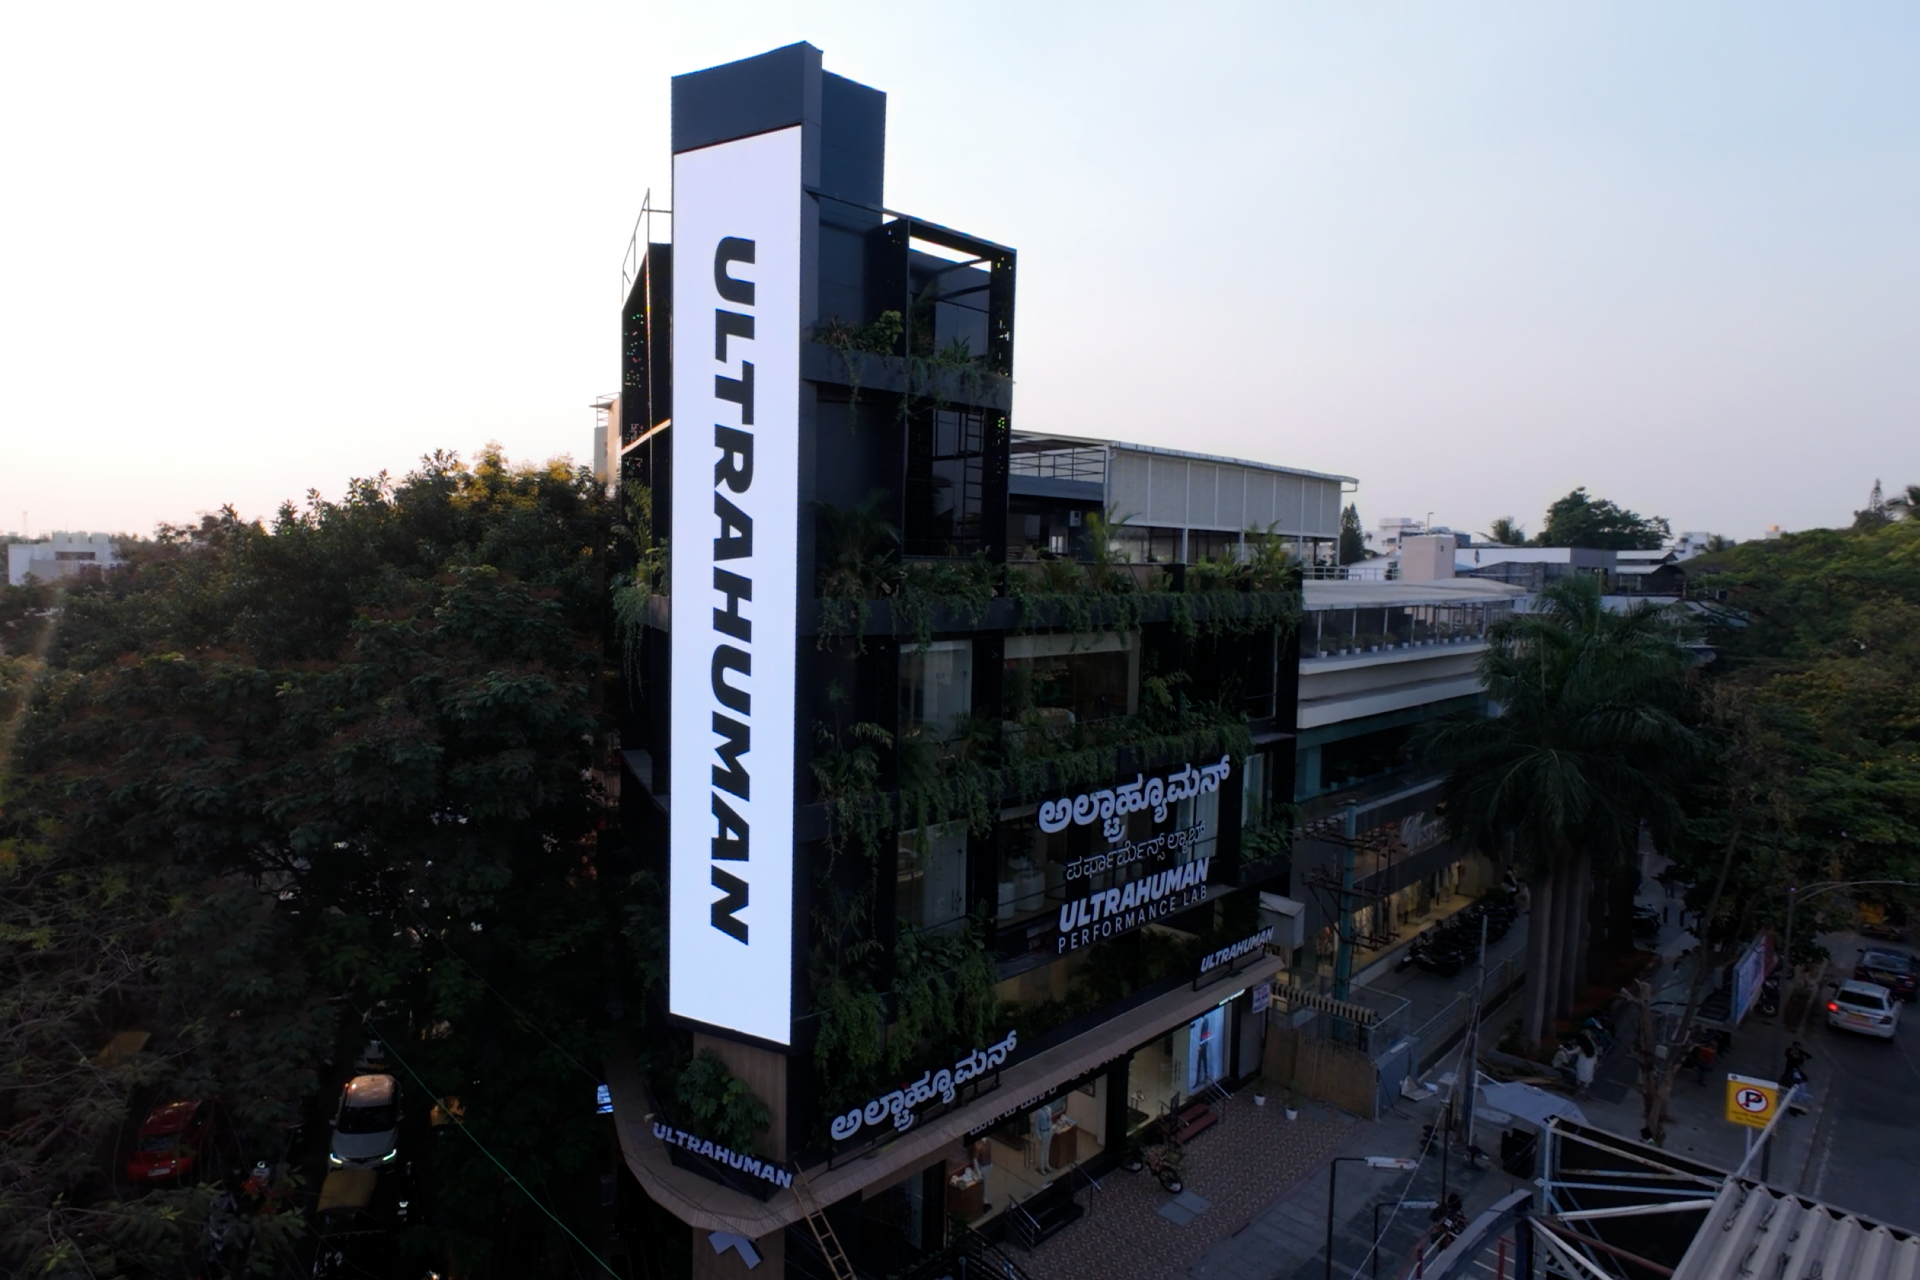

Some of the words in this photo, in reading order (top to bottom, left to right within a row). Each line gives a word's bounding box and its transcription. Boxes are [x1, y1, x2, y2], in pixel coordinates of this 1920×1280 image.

[711, 236, 757, 946] ULTRAHUMAN
[1038, 754, 1231, 843] ಅಲ್ಟ್ರಾಹ್ಯೂಮನ್
[1058, 857, 1210, 934] ULTRAHUMAN
[1058, 896, 1176, 954] PERFORMANCE
[1183, 884, 1207, 907] LAB
[1200, 926, 1274, 973] ULTRAHUMAN
[829, 1028, 1018, 1141] ಅಲ್ಟ್ರಾಹ್ಯೂಮನ್
[653, 1121, 794, 1189] ULTRAHUMAN
